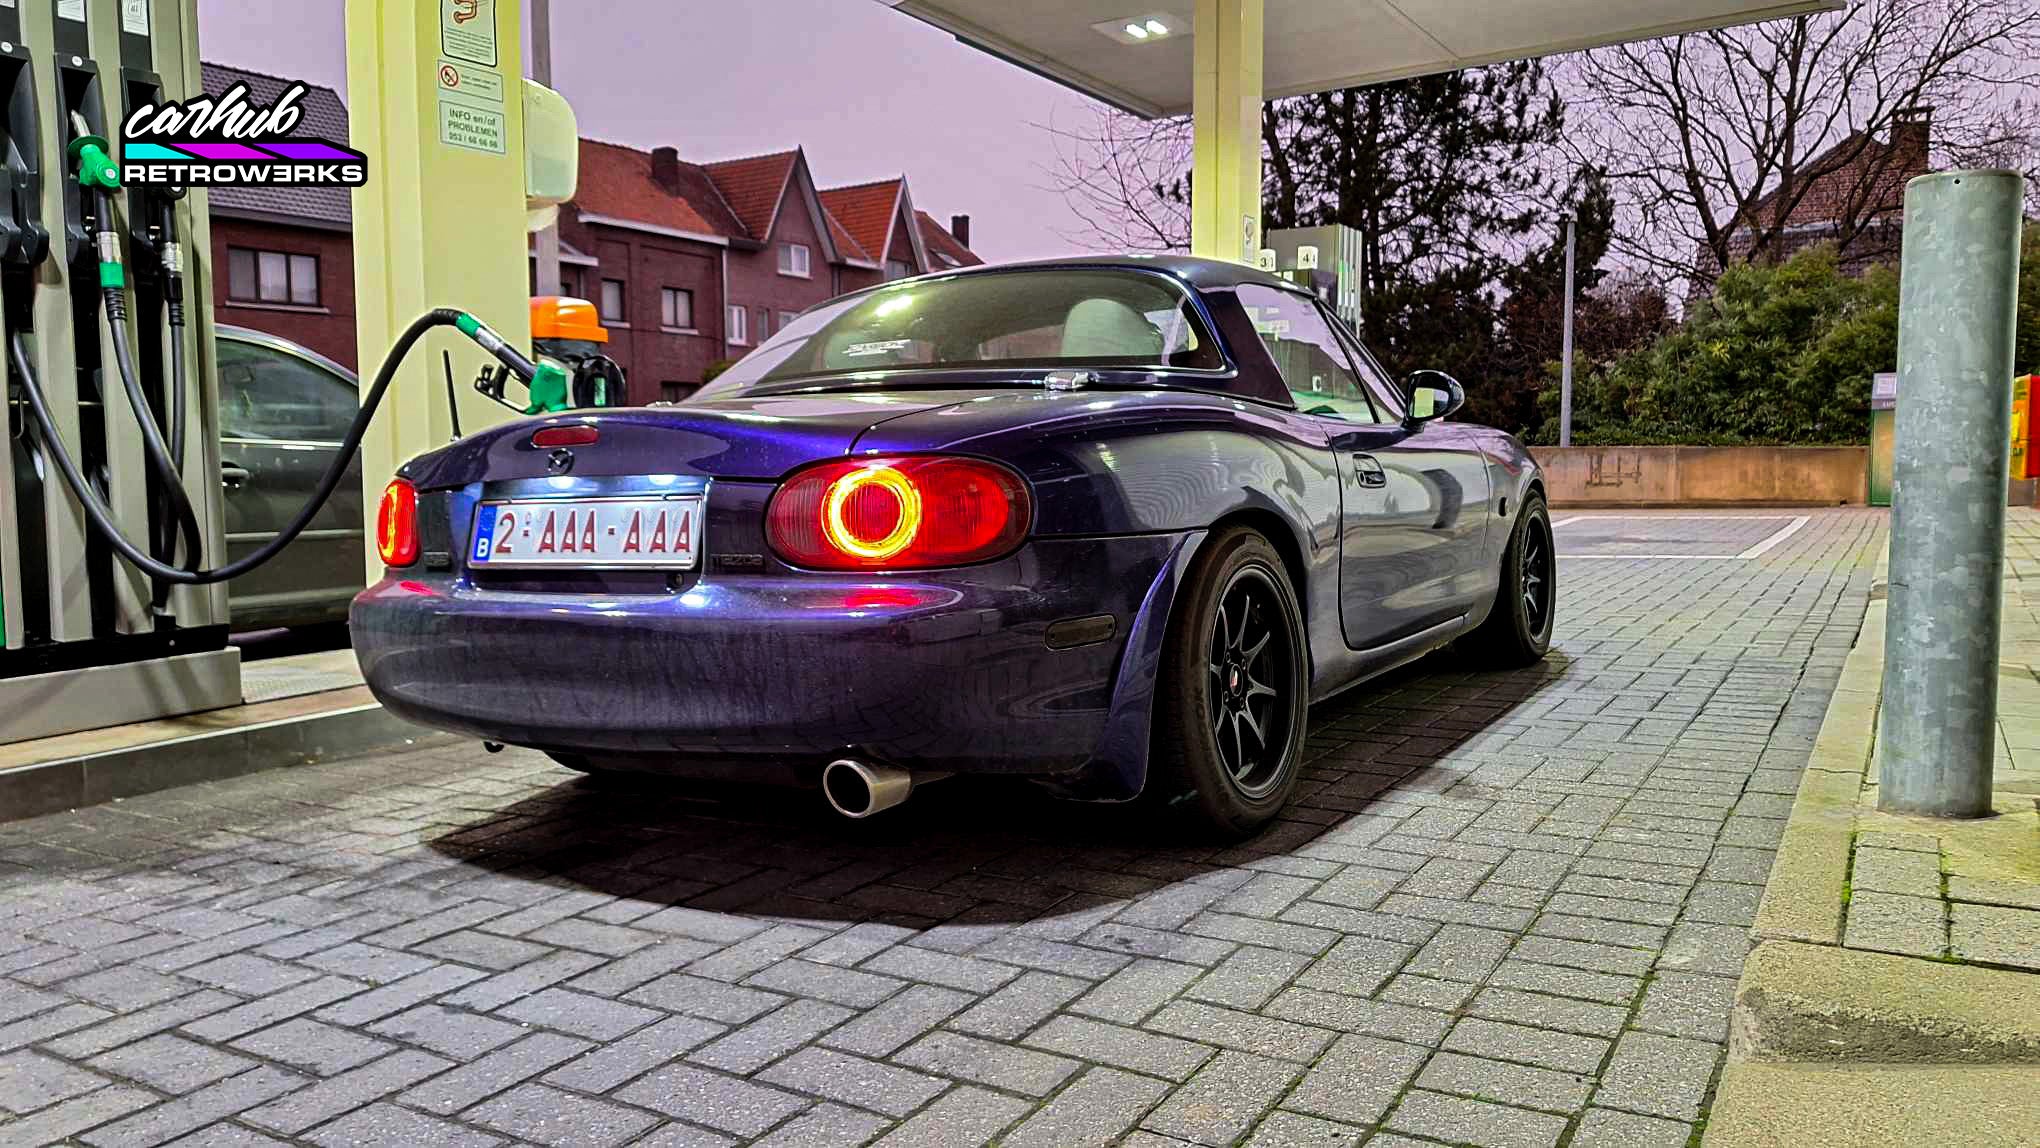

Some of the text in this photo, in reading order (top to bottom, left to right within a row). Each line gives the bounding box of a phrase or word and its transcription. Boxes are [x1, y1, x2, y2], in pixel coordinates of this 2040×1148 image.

[449, 108, 471, 120] INFO
[448, 120, 498, 137] PROBLEMEN
[476, 537, 489, 558] B
